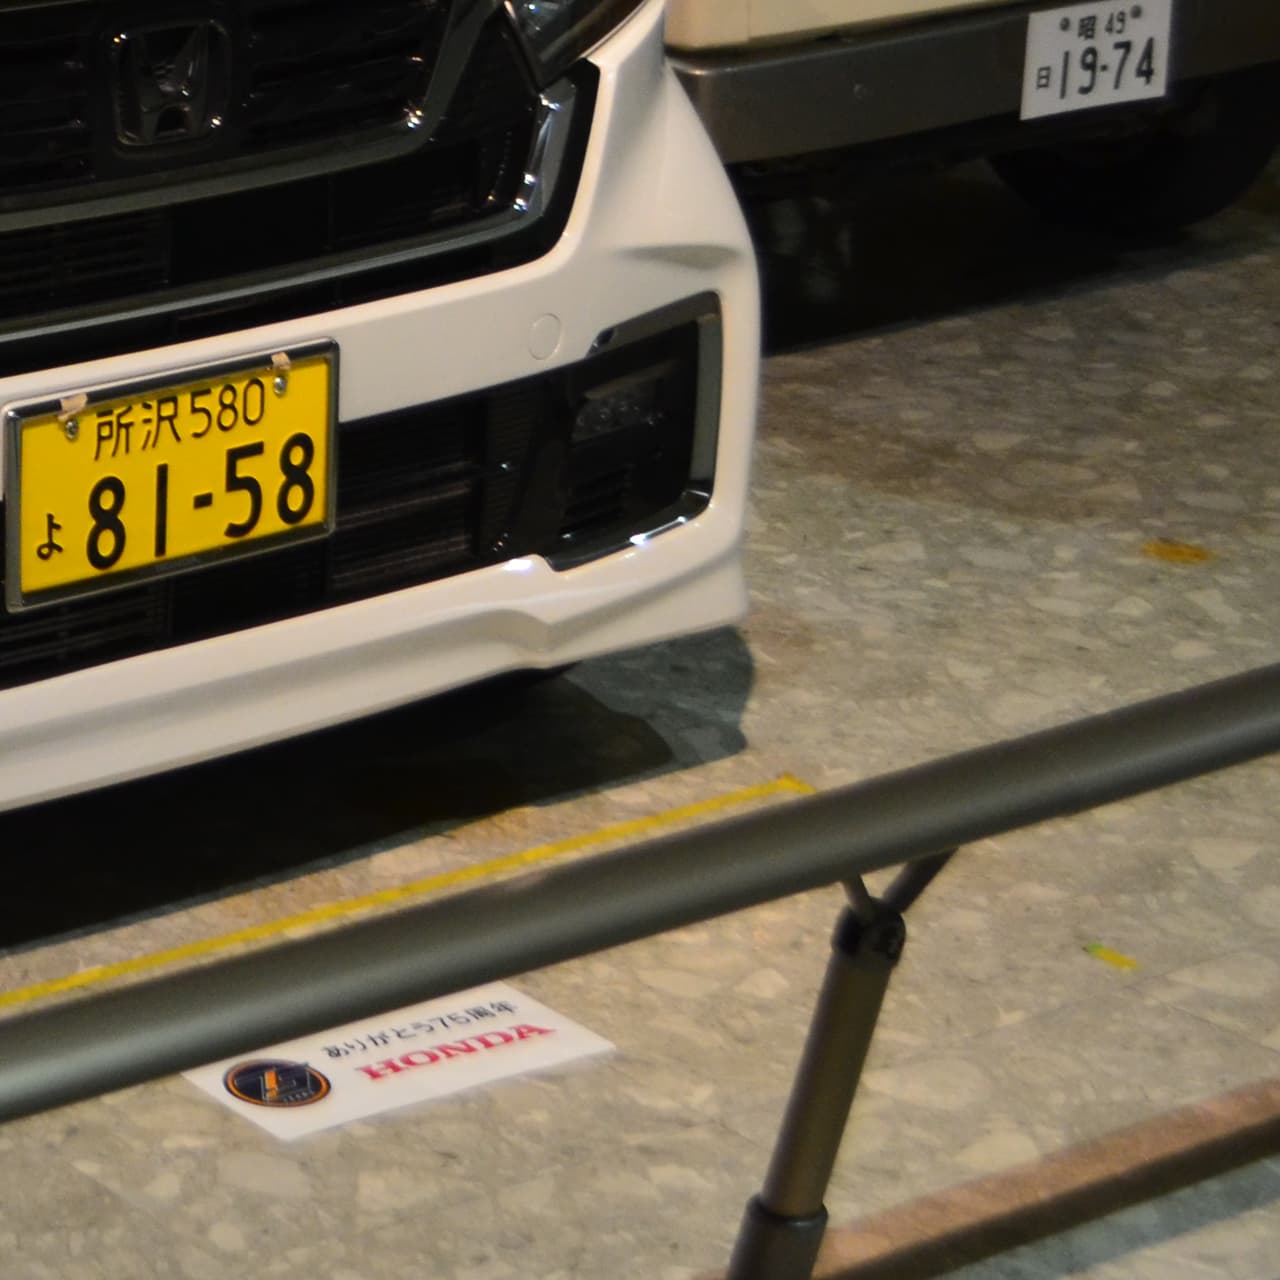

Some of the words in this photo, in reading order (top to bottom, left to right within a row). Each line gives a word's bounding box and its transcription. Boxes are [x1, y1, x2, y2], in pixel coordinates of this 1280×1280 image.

[1060, 36, 1155, 99] 19-74
[36, 513, 64, 561] よ
[86, 432, 315, 570] 81-58
[322, 999, 519, 1059] ありがとう75周年
[354, 1023, 556, 1080] HONDA
